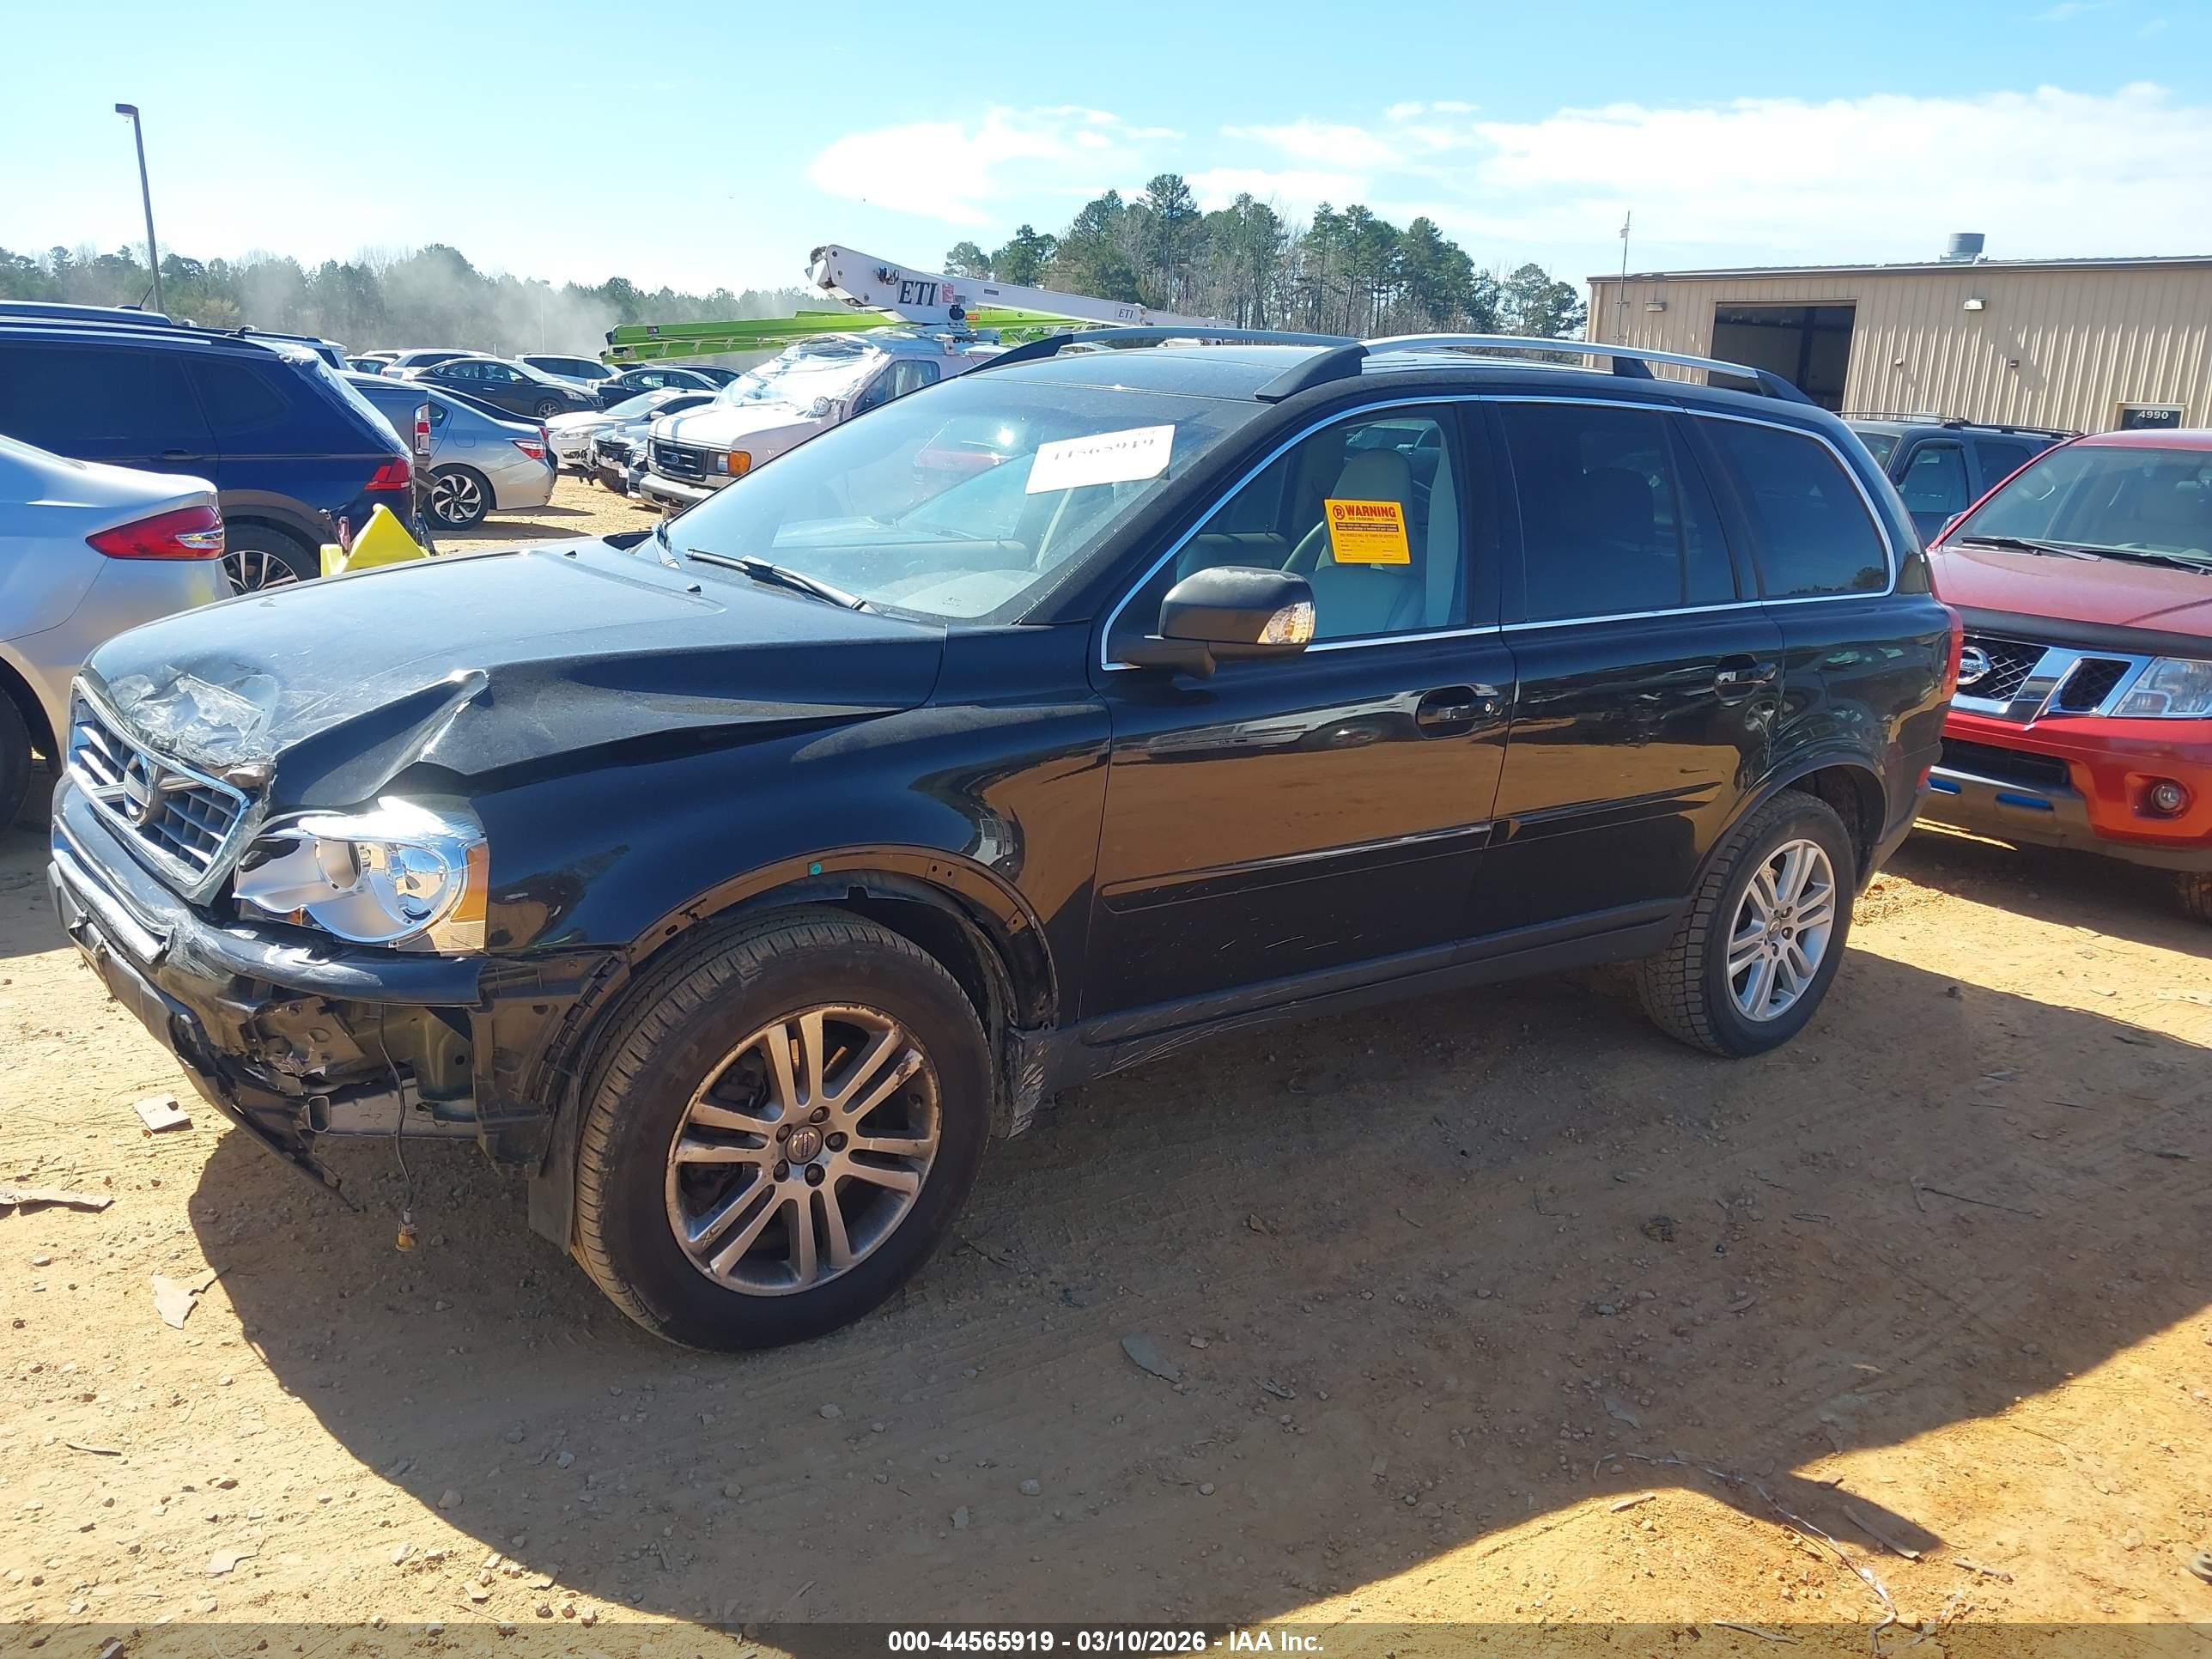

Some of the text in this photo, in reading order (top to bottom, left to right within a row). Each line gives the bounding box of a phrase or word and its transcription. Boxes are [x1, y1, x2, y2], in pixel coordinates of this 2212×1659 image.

[897, 280, 938, 307] ETI
[1118, 308, 1134, 319] ETI
[2136, 410, 2169, 420] 4990
[1345, 505, 1396, 518] WARNING
